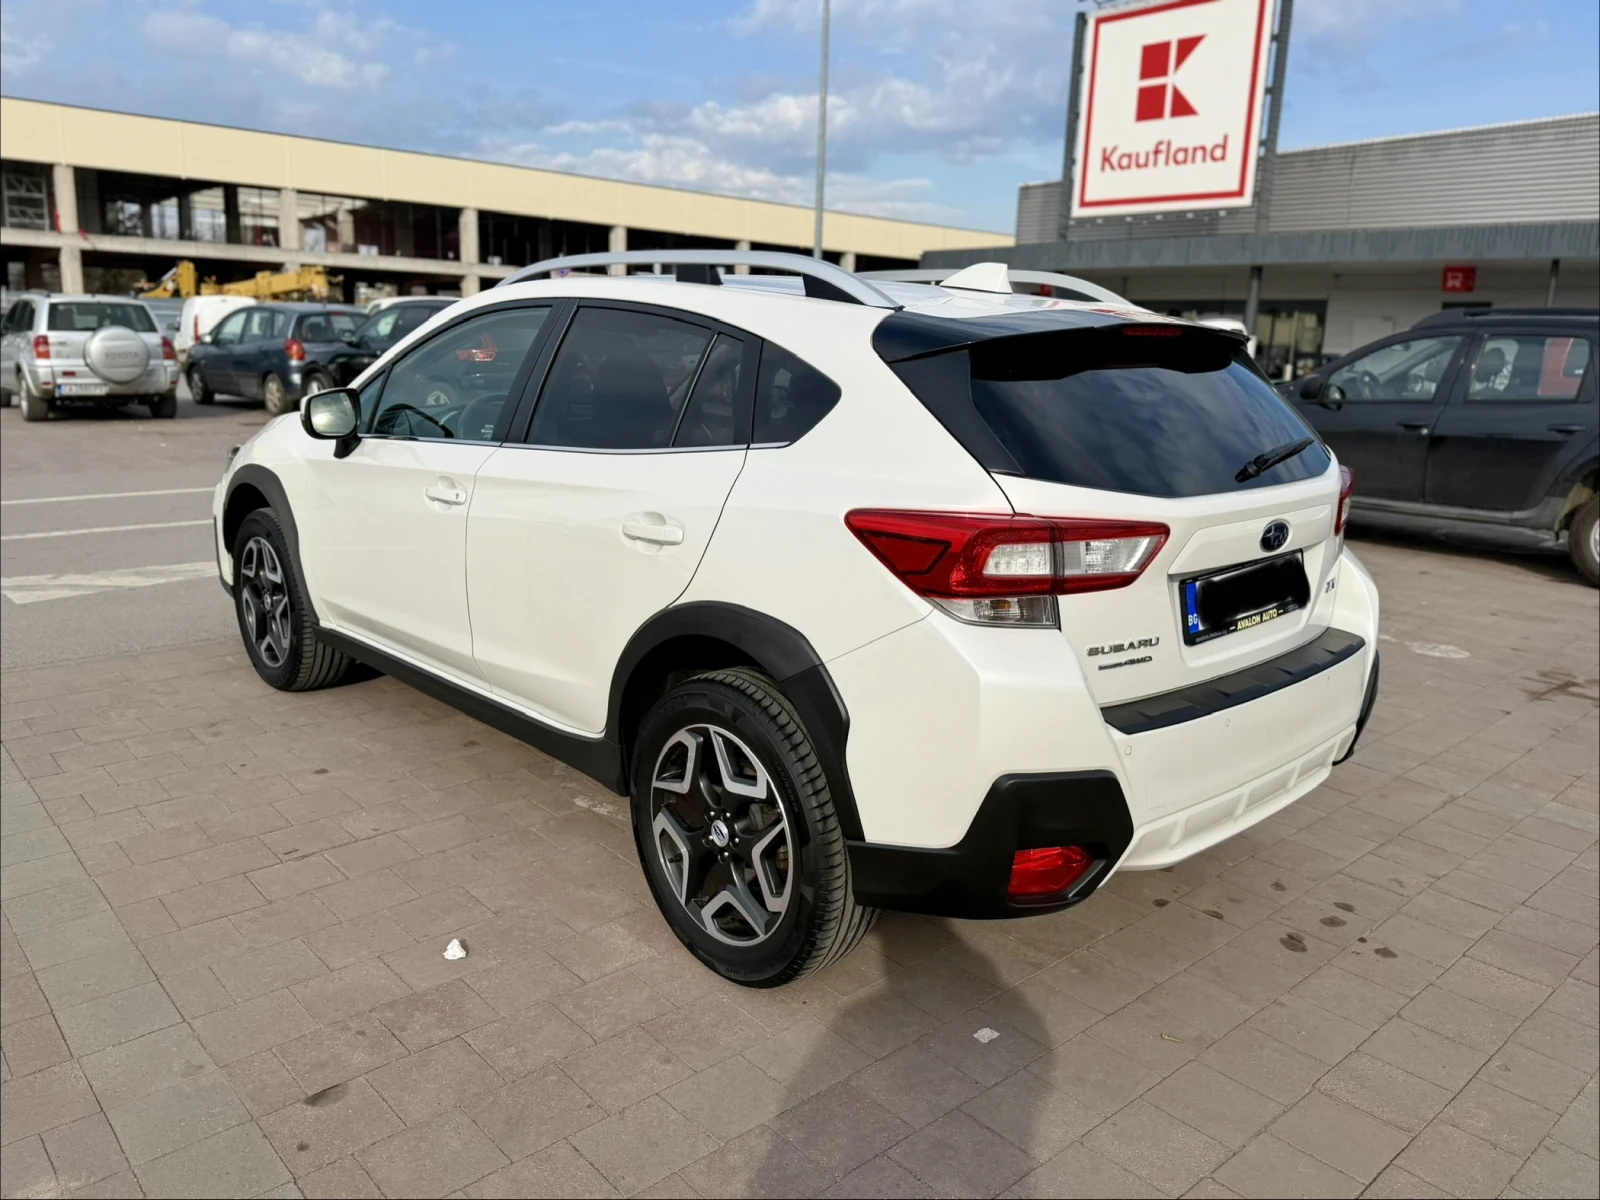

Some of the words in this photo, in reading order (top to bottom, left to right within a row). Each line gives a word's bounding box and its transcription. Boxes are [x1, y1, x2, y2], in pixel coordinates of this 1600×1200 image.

[1100, 133, 1228, 172] Kaufland
[1188, 613, 1198, 626] BG
[1237, 614, 1261, 631] AVALON
[1262, 609, 1278, 621] AUTO
[1086, 636, 1160, 657] SUBARU
[1123, 655, 1153, 666] AWD
